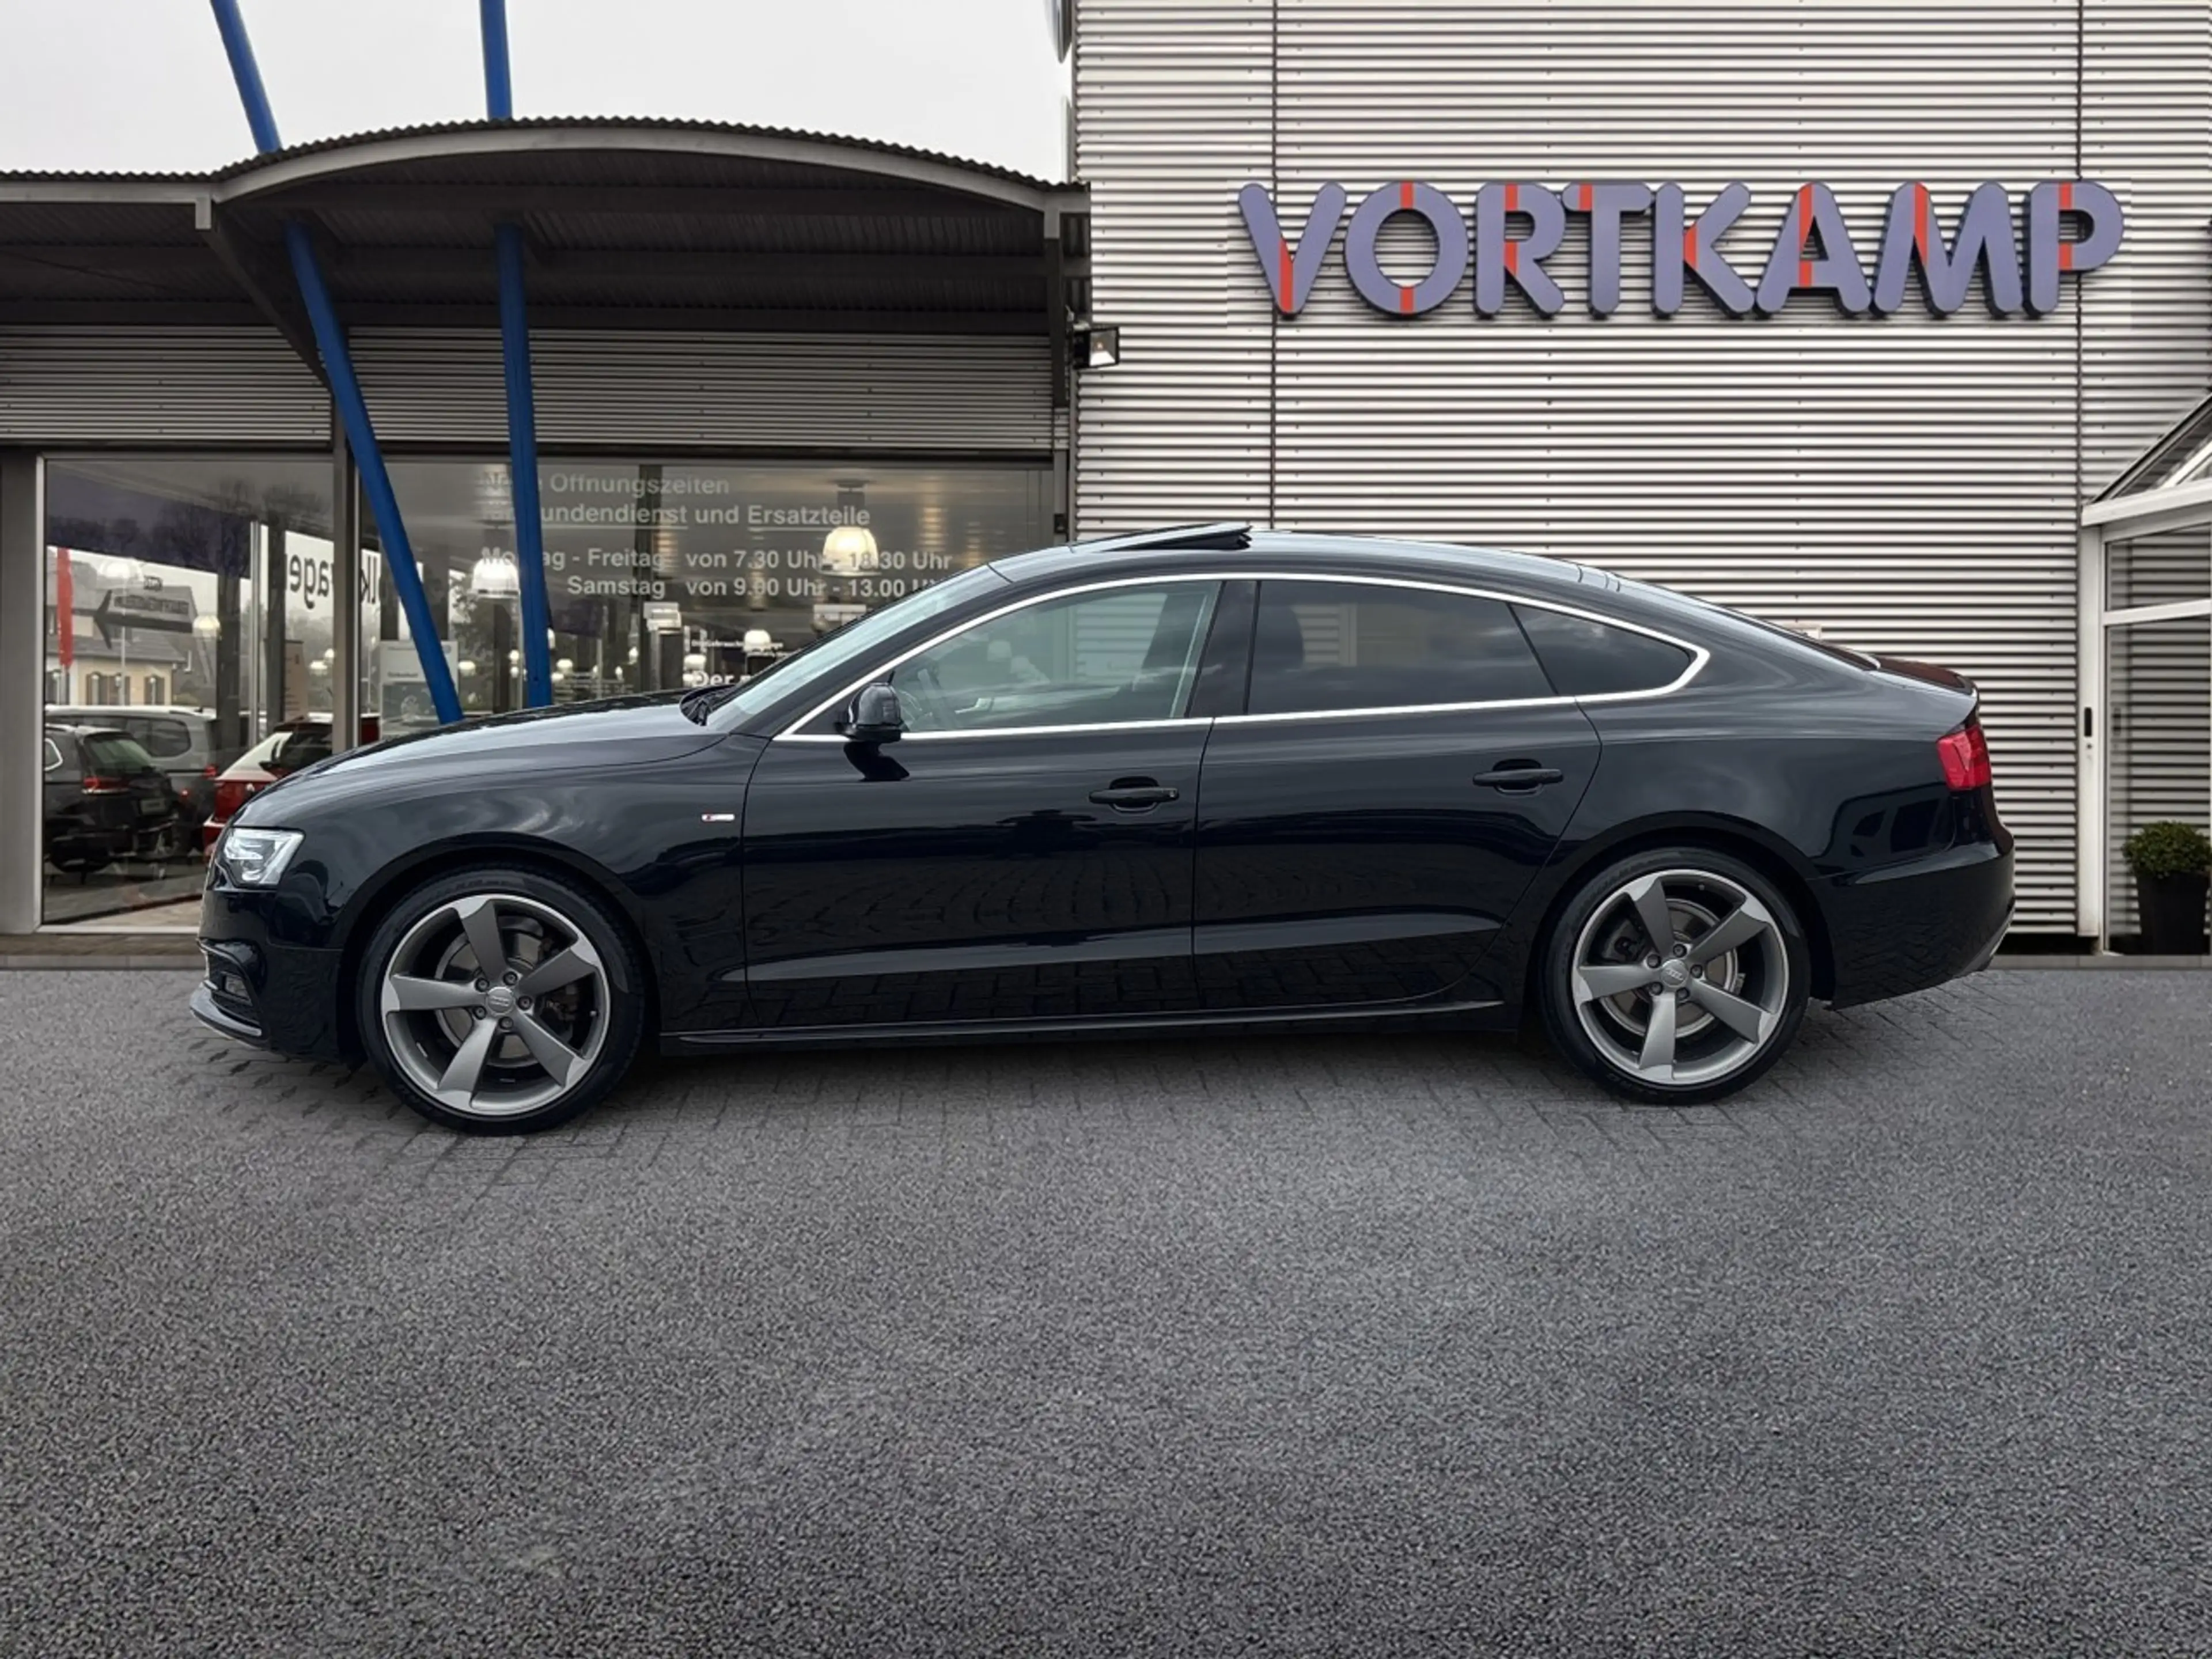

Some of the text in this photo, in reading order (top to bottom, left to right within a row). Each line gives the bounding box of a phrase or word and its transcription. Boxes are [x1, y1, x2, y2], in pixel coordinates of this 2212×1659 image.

[1237, 180, 2124, 316] VORTKAMP
[540, 505, 687, 524] undendienst
[695, 505, 738, 524] und
[748, 506, 870, 525] Ersatzteile
[482, 547, 565, 570] Moag
[588, 549, 665, 570] Freitag
[685, 552, 727, 567] von
[733, 551, 779, 569] 7.30
[912, 550, 953, 570] Uhr
[566, 576, 665, 599] Samstag
[685, 582, 727, 596] von
[787, 579, 826, 596] Uhr
[848, 579, 905, 597] 13.00
